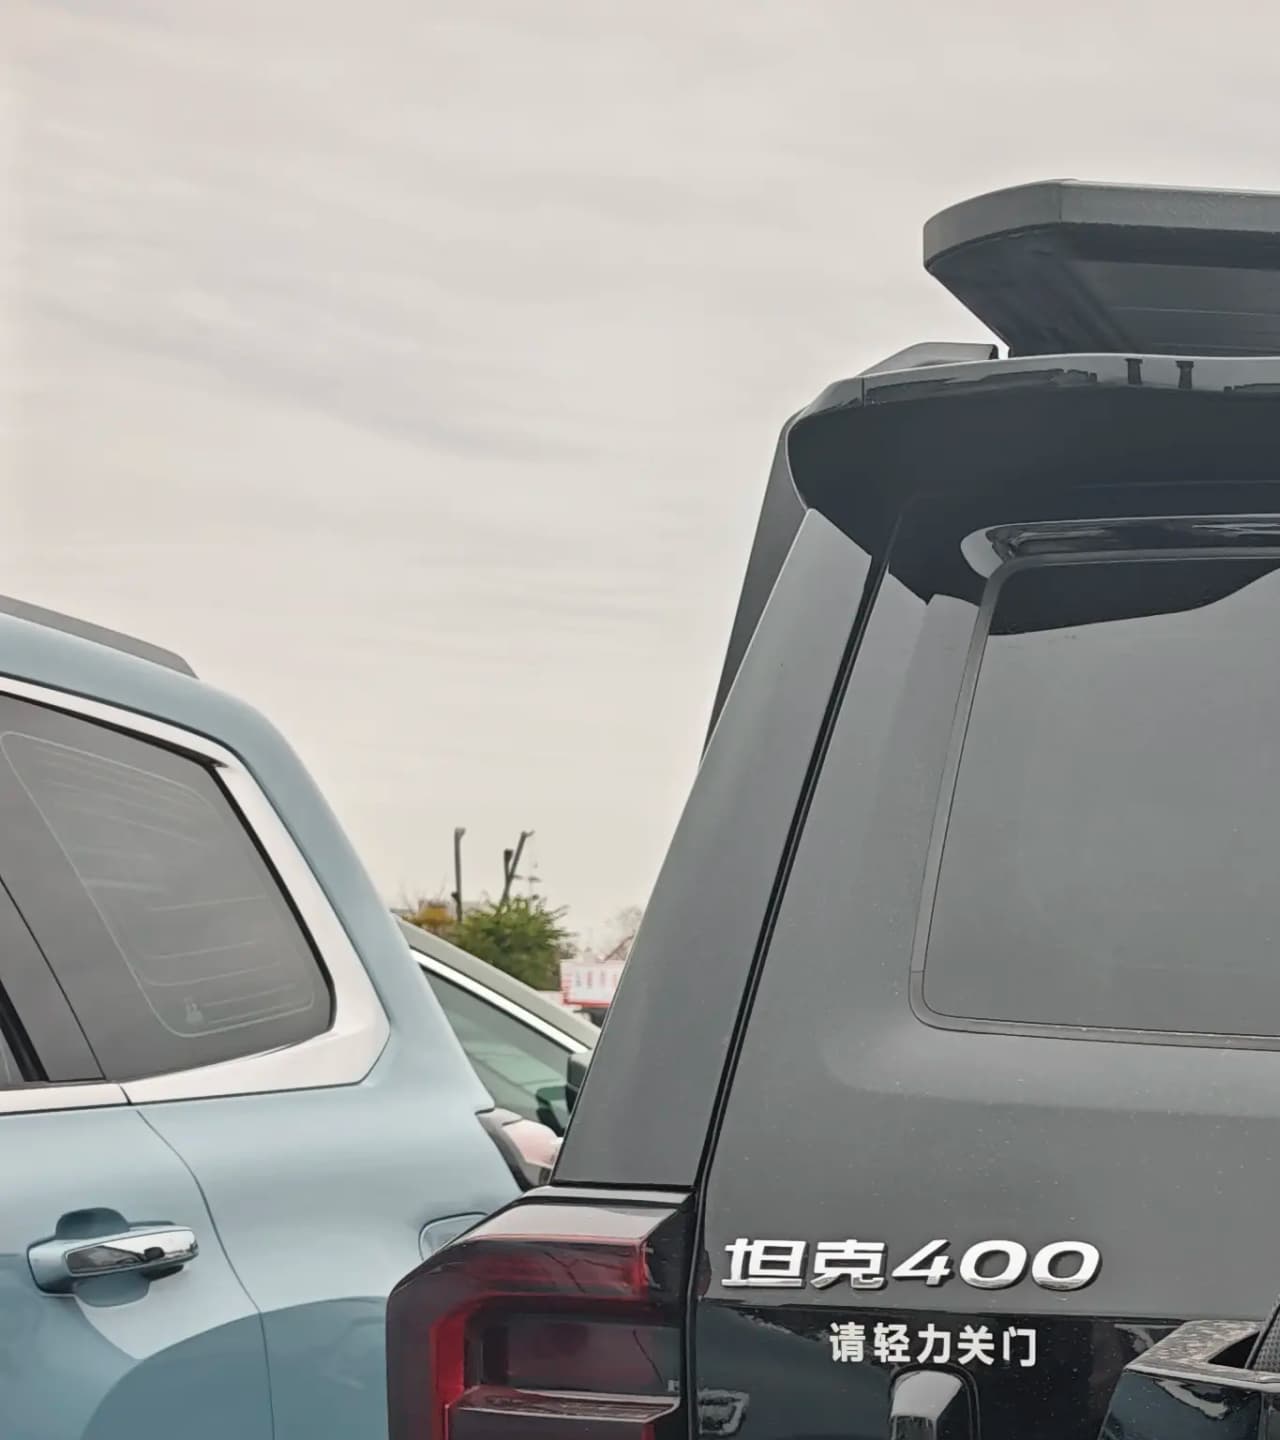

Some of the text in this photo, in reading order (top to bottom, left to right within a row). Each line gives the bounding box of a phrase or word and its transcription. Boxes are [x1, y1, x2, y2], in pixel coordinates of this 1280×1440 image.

[720, 1237, 1102, 1292] 坦克400
[829, 1321, 1038, 1368] 请轻力关门
